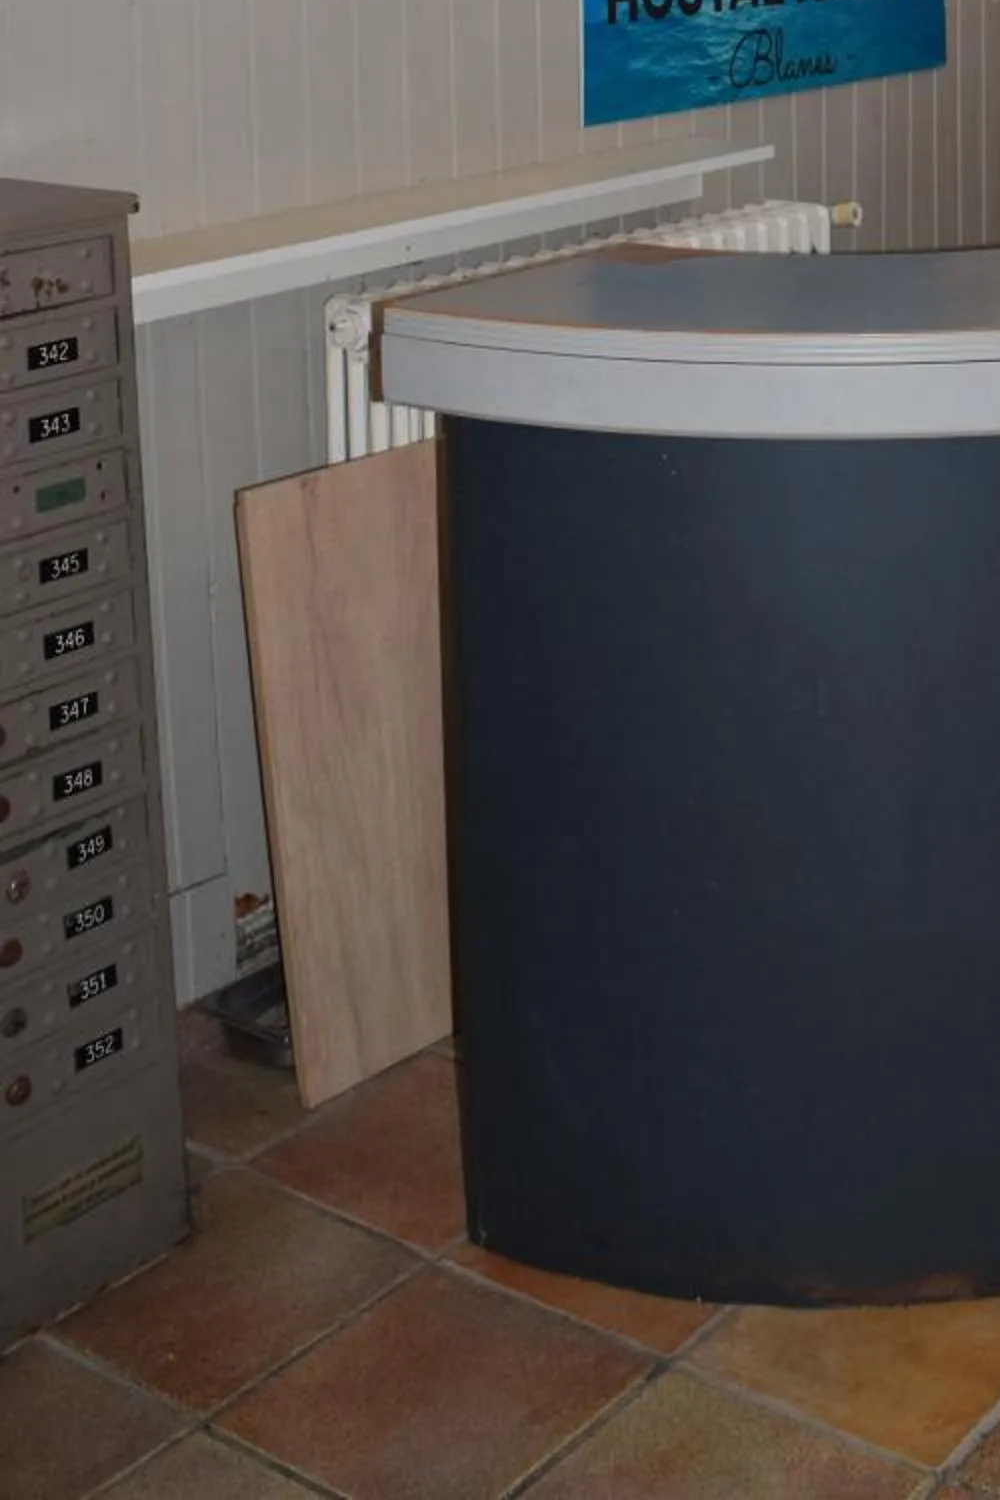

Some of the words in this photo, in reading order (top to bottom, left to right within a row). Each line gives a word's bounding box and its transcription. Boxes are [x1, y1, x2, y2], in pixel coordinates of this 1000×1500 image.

[39, 341, 69, 365] 342
[40, 414, 70, 438] 343
[50, 555, 79, 580] 345
[55, 629, 86, 657] 346
[60, 698, 90, 724] 347
[63, 768, 93, 794] 348
[78, 835, 106, 862] 349
[74, 905, 105, 931] 350
[81, 973, 107, 1000] 351
[86, 1036, 115, 1064] 352
